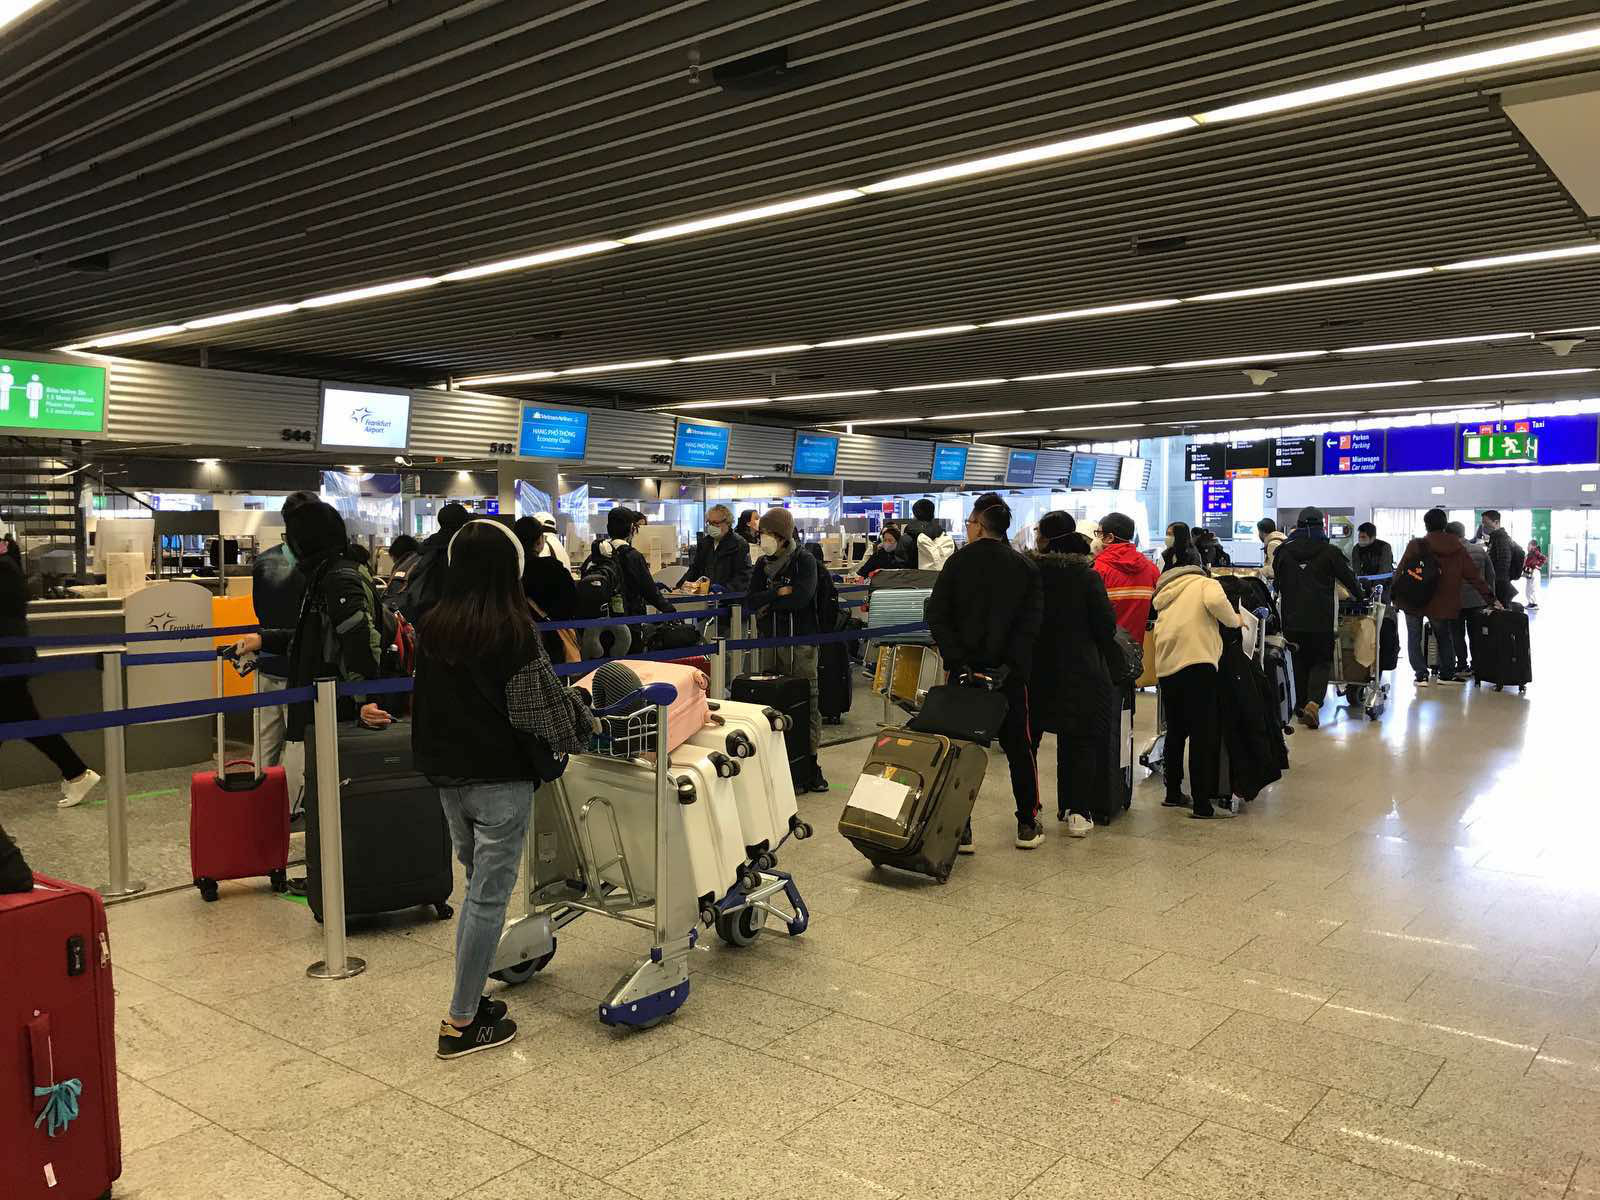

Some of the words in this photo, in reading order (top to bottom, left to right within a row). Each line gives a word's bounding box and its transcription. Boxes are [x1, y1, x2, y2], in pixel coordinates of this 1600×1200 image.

[365, 419, 392, 428] Frankfurt
[1532, 420, 1545, 428] Taxi
[364, 426, 385, 434] Airport
[489, 442, 513, 454] 543
[1265, 487, 1274, 499] 5
